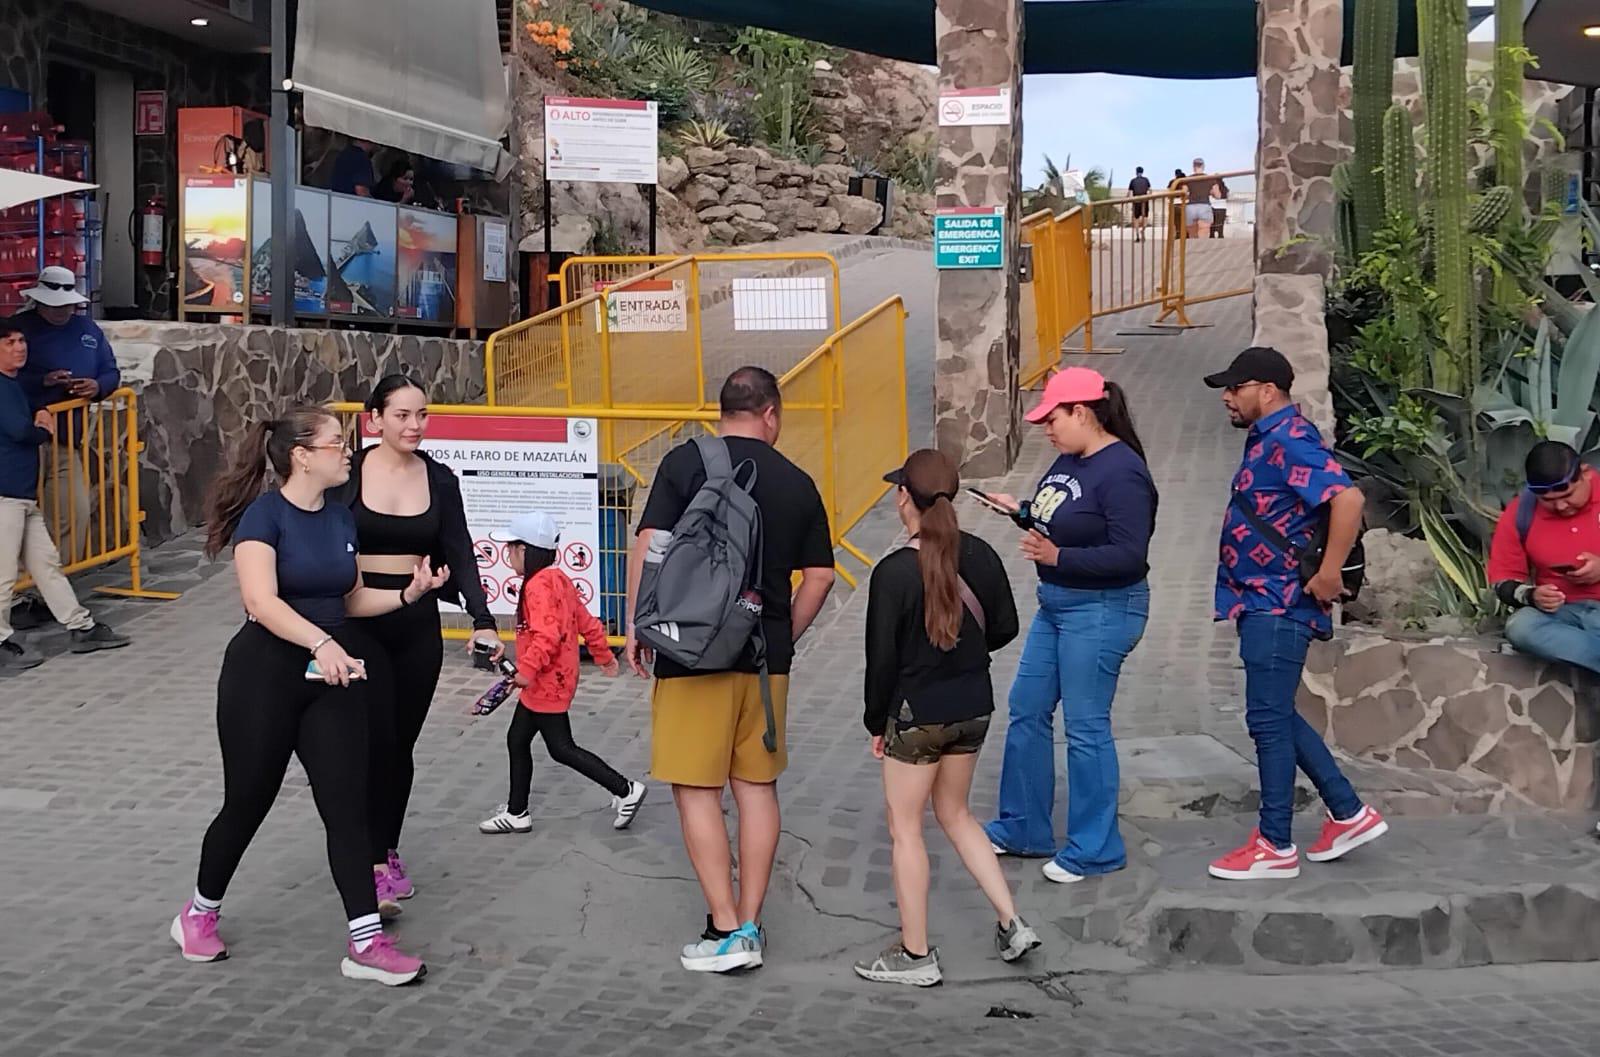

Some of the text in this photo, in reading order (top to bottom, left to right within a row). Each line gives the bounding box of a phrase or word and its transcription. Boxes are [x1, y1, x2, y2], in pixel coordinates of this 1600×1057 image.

[972, 103, 1003, 111] ESPACIO
[562, 111, 591, 121] ALTO
[944, 218, 994, 229] SALIDA DE
[938, 230, 1001, 240] EMERGENCIA
[940, 243, 999, 254] EMERGENCY
[958, 255, 980, 265] EXIT
[620, 300, 681, 312] ENTRADA
[620, 313, 682, 325] ENTRANCE
[426, 449, 587, 463] DOS AL FARO DE MAZATLÁN
